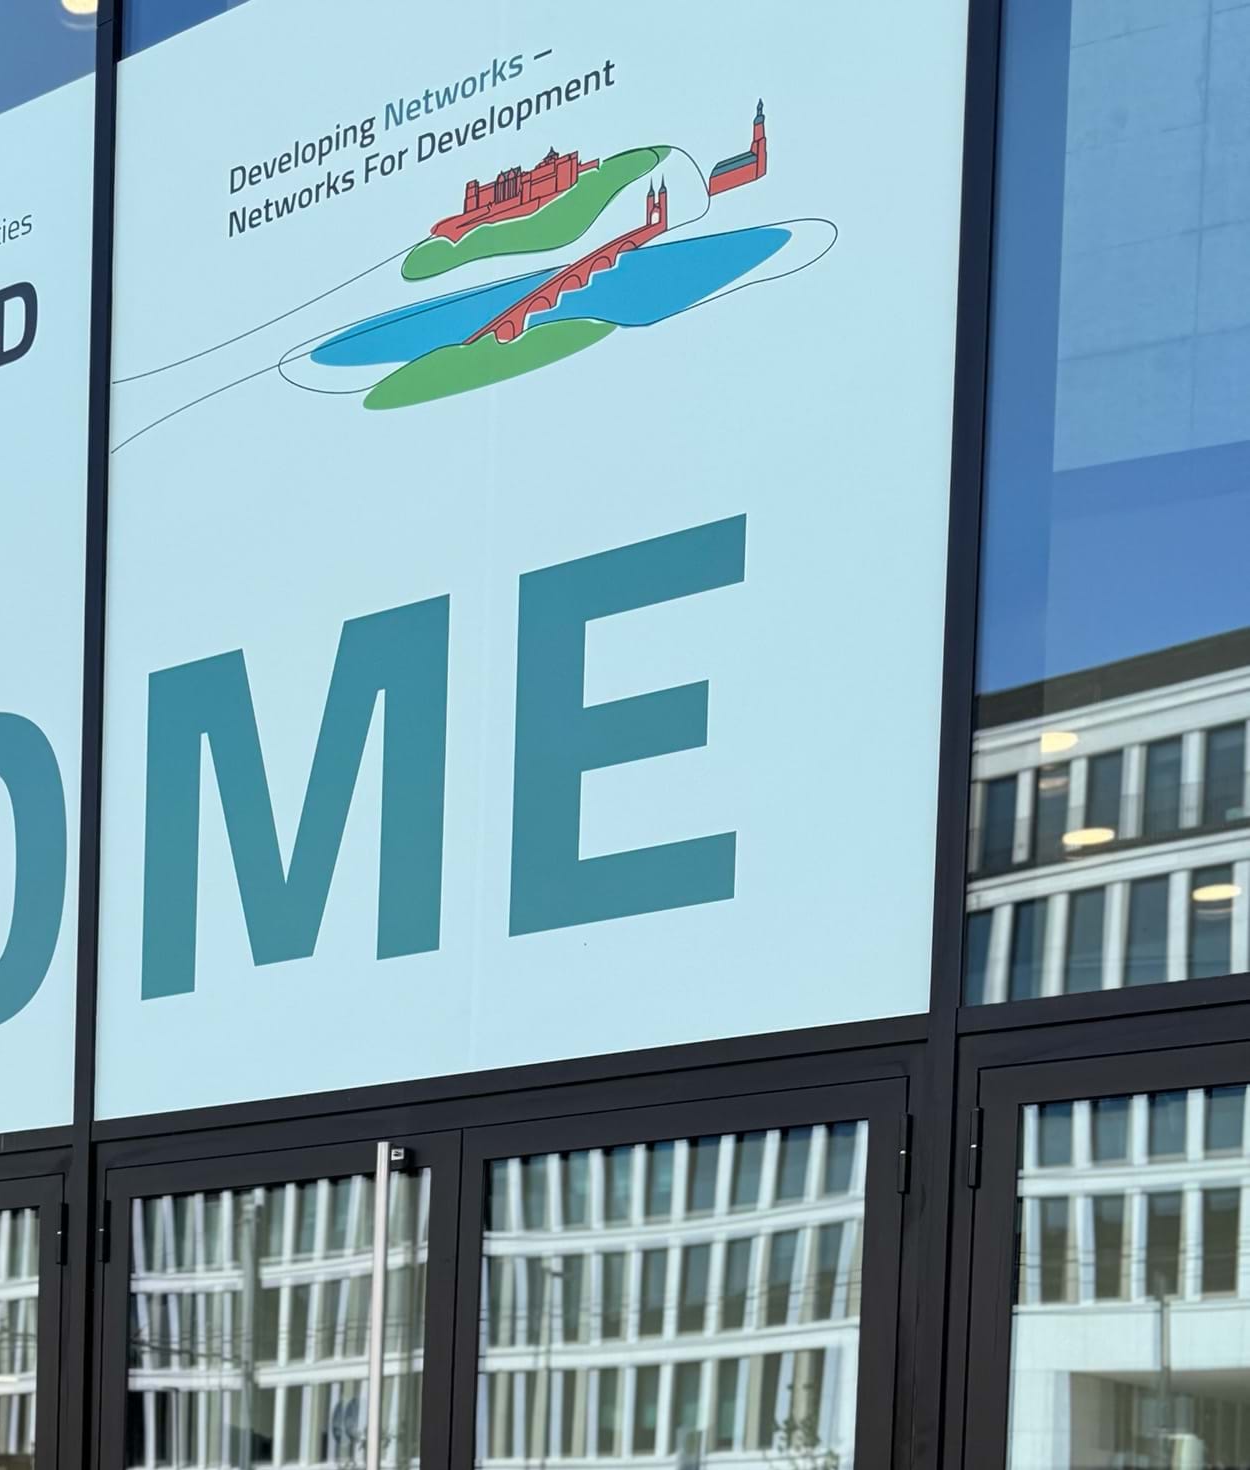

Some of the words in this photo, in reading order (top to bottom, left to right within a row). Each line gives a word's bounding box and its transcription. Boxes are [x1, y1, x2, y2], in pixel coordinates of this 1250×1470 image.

[229, 170, 354, 237] Networks
[365, 148, 408, 184] For
[418, 60, 615, 163] Development
[230, 116, 375, 194] Developing
[385, 55, 522, 130] Networks
